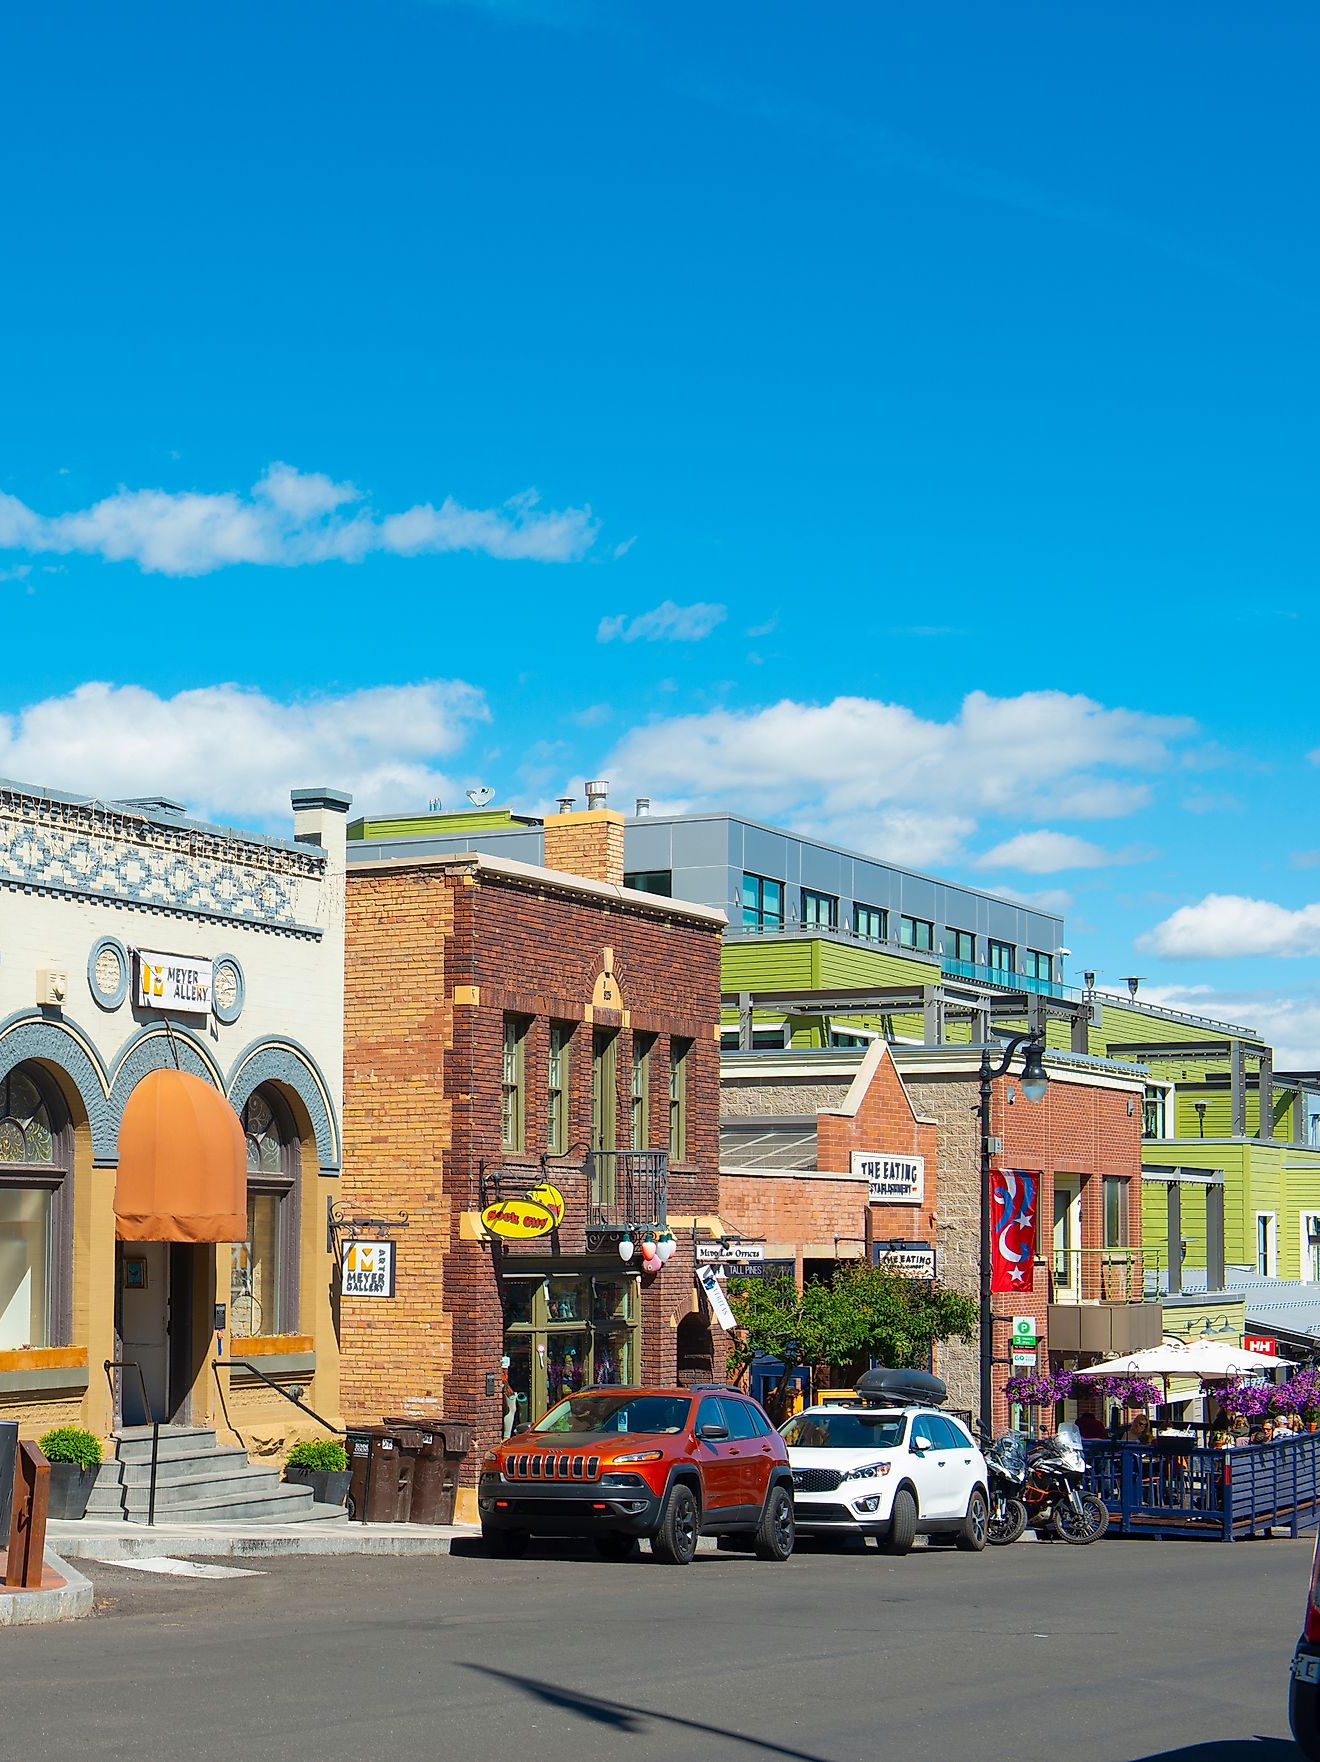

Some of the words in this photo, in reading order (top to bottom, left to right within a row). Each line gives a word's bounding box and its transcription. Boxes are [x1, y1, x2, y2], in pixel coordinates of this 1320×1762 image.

[167, 967, 199, 984] MEYER
[861, 1161, 880, 1180] THE
[883, 1161, 917, 1184] EATING
[869, 1183, 912, 1196] STABLISHMENT
[487, 1209, 520, 1226] Sock
[523, 1215, 548, 1230] Guy
[378, 1249, 386, 1272] ART
[899, 1254, 931, 1266] EATING
[730, 1265, 744, 1275] TALL
[745, 1265, 762, 1275] PINES
[347, 1272, 385, 1284] MEYER
[346, 1282, 385, 1293] GALLERY
[1015, 1336, 1021, 1344] 3
[1249, 1340, 1270, 1352] HH
